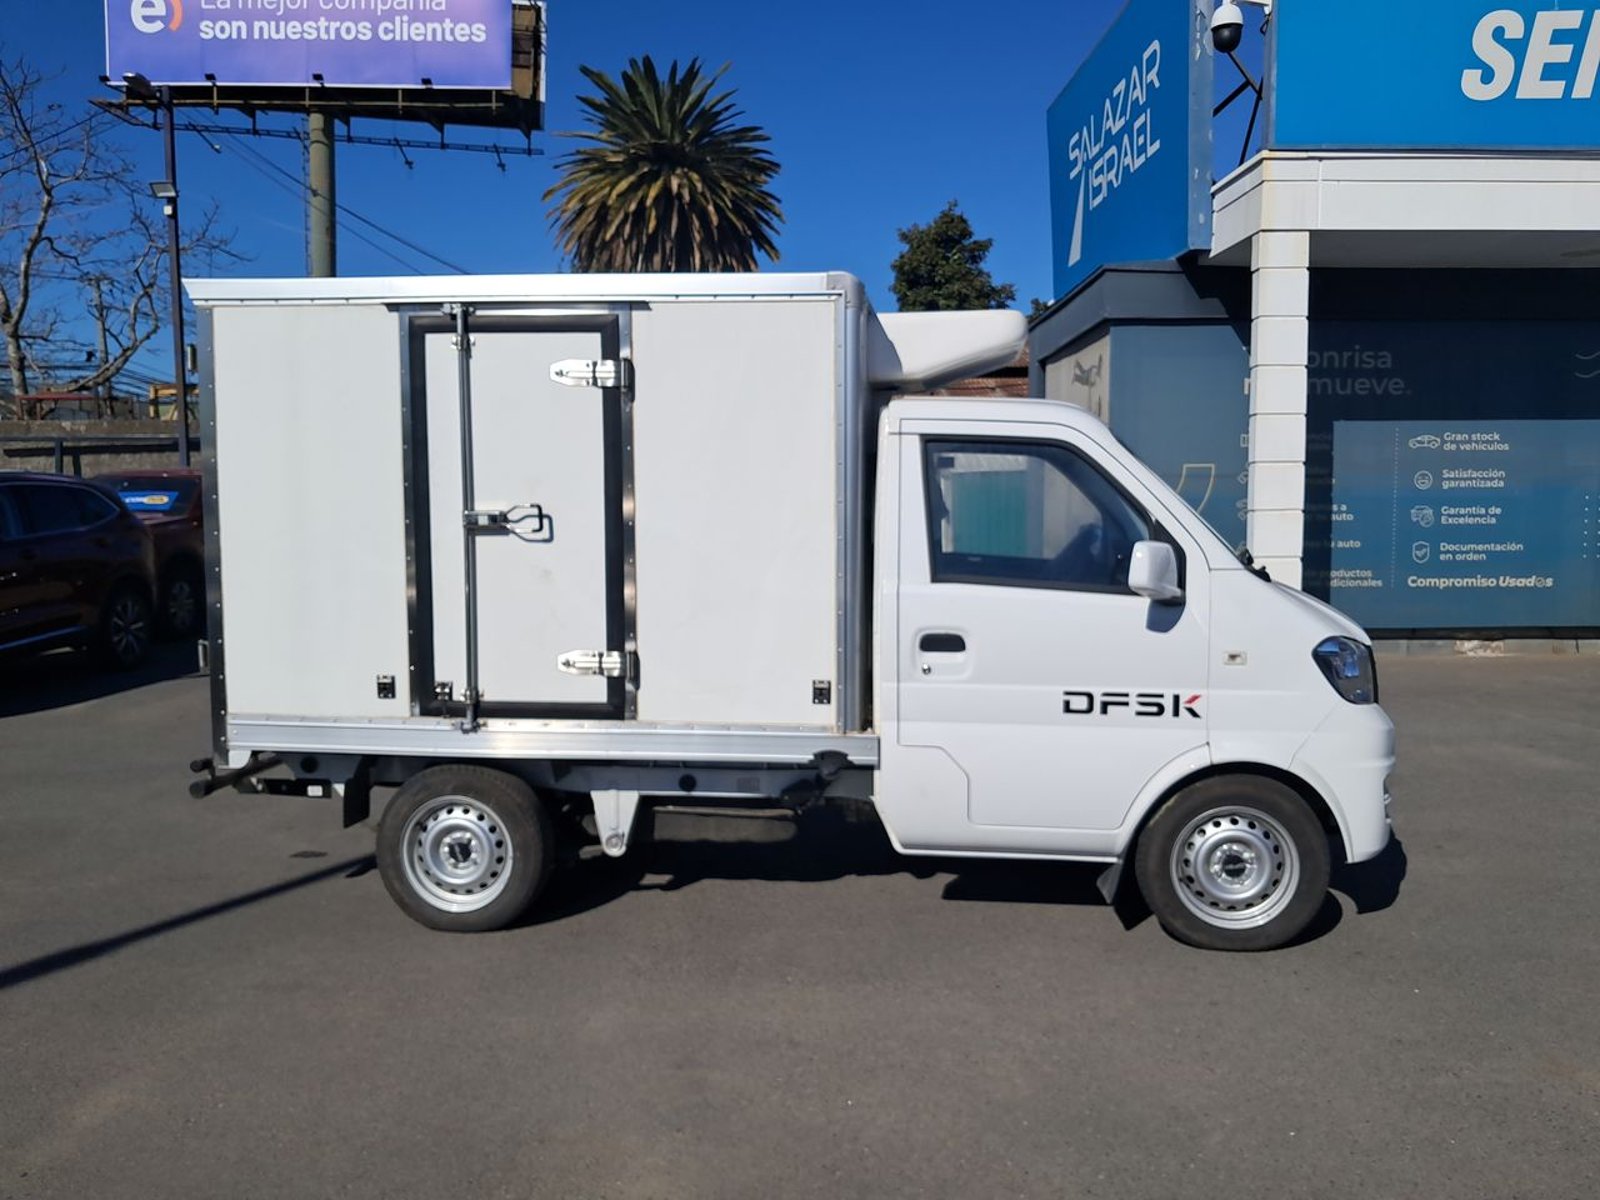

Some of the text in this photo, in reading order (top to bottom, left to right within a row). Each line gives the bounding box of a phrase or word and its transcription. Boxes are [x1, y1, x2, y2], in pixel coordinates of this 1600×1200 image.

[200, 15, 487, 43] son nuestros clientes
[1069, 39, 1161, 180] SALAZAR
[1089, 108, 1161, 211] ISRAEL
[1307, 344, 1393, 370] onrisa
[1443, 432, 1501, 441] Gran stock
[1443, 441, 1510, 451] de vehículos
[1442, 468, 1506, 479] Satisfacción
[1442, 479, 1505, 490] garantizada
[1441, 505, 1502, 515] Garantía de
[1441, 515, 1497, 525] Excelencia
[1336, 540, 1361, 548] auto
[1439, 541, 1524, 552] Documentación
[1440, 552, 1487, 561] en orden
[1407, 575, 1498, 590] Compromiso
[1063, 691, 1203, 719] DFSK
